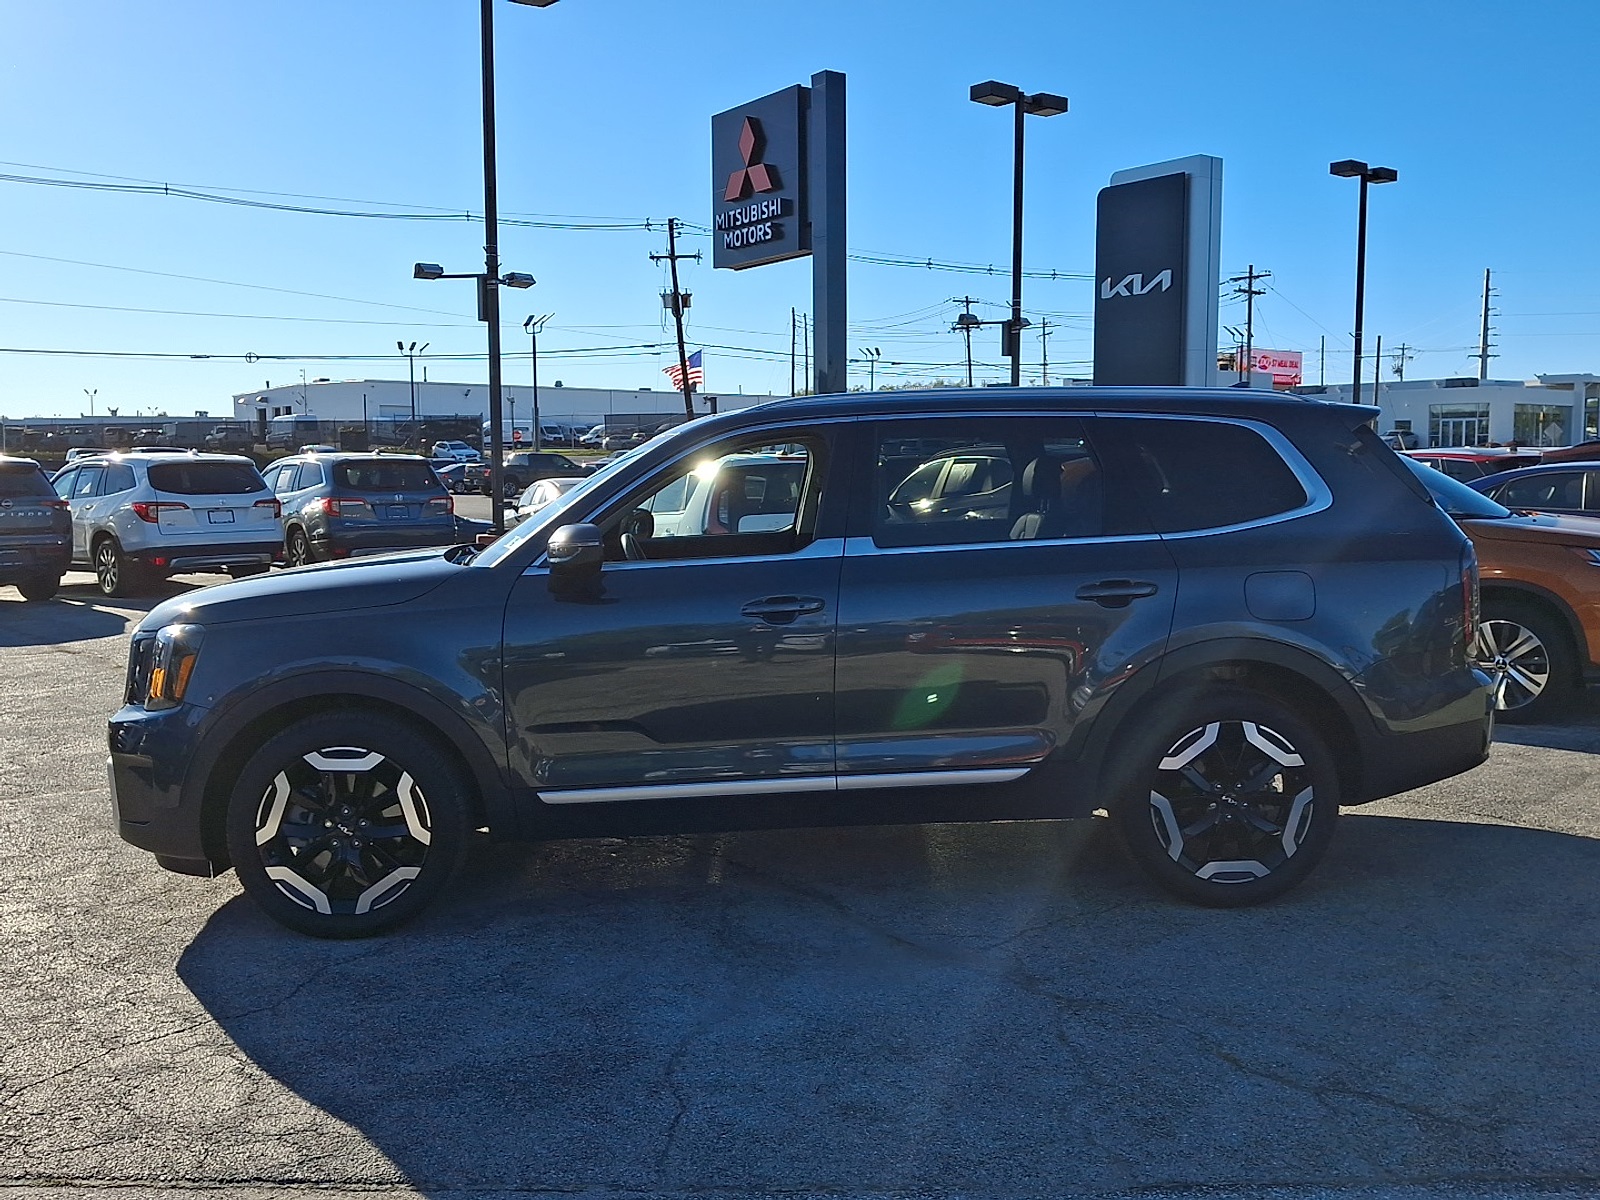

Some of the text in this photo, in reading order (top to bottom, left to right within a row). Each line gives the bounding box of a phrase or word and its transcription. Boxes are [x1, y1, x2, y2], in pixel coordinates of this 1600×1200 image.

[716, 198, 781, 230] MITSUBISHI
[724, 222, 772, 249] MOTORS
[1101, 269, 1172, 299] KIA
